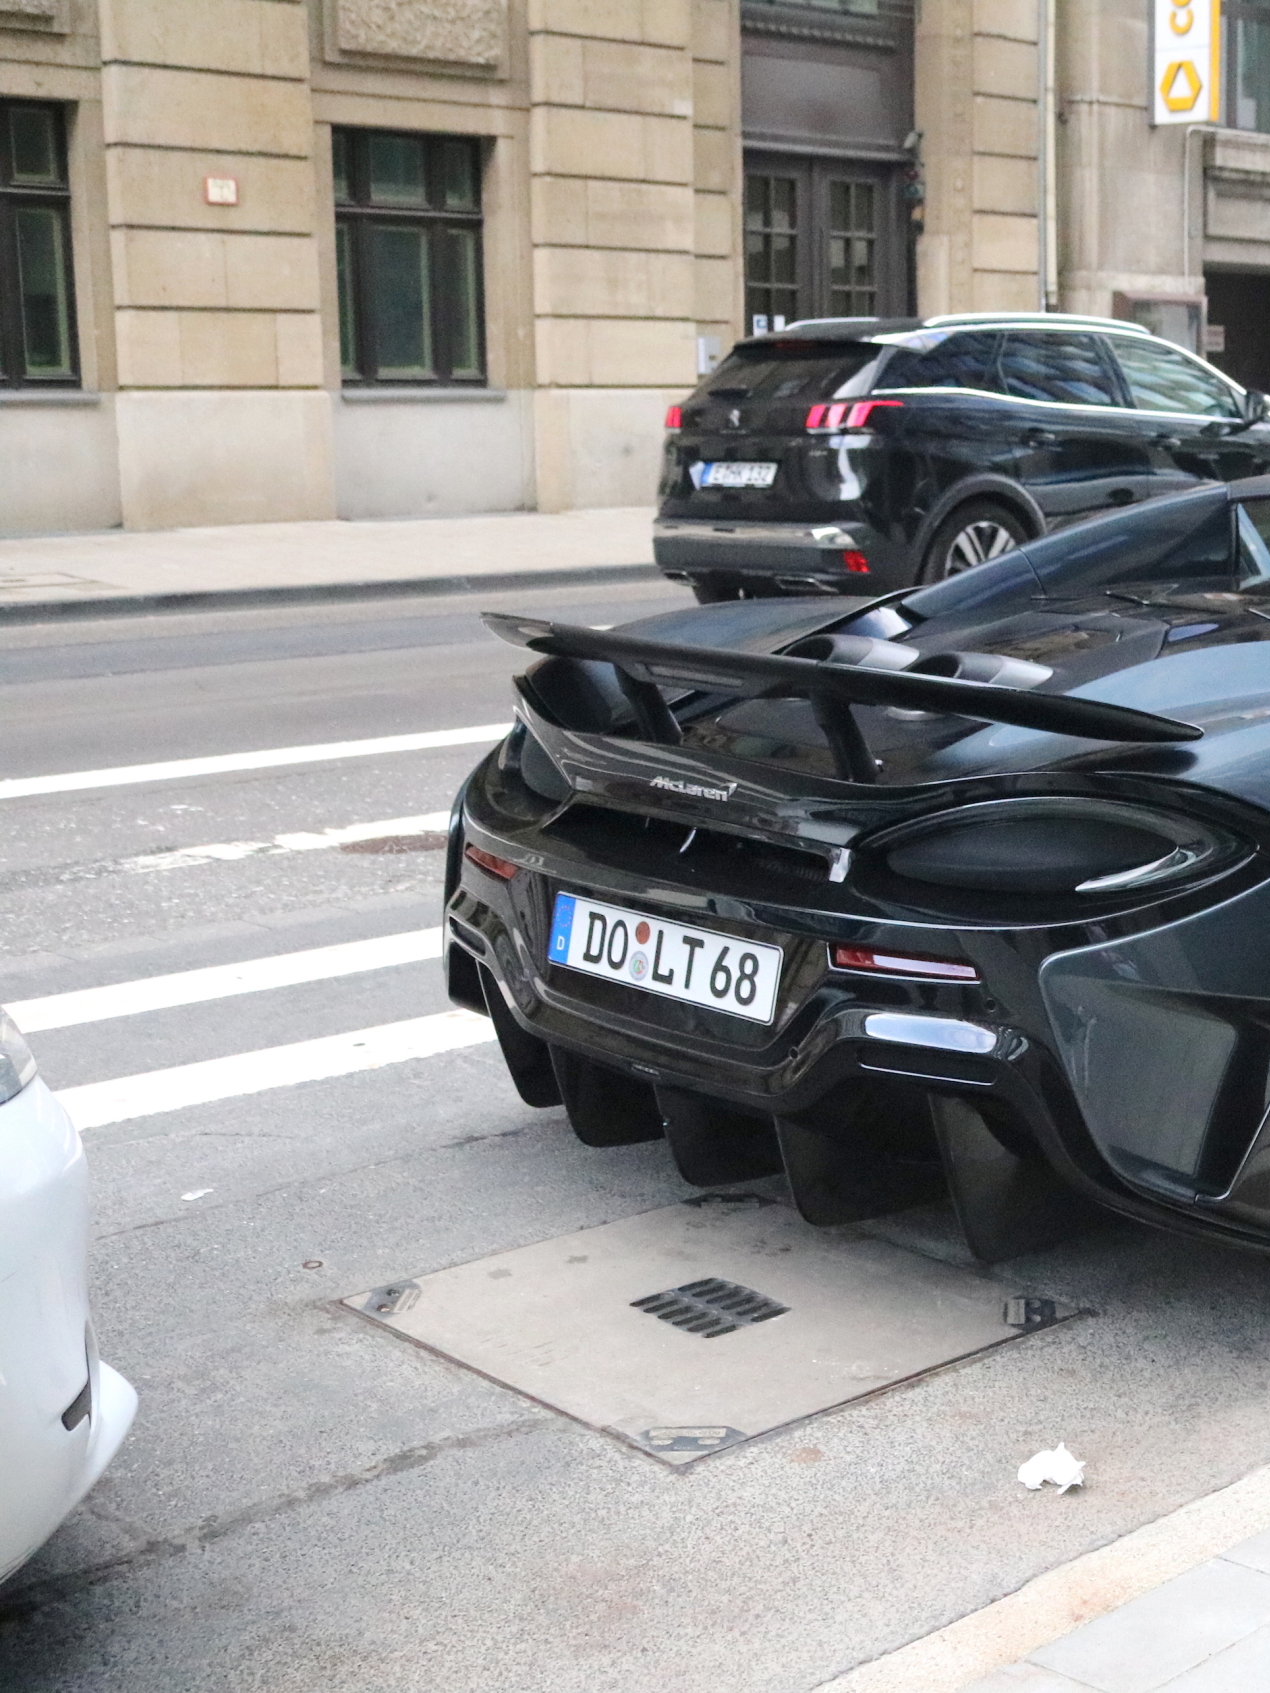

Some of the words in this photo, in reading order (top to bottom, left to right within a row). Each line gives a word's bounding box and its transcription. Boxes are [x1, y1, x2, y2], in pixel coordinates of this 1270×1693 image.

[1169, 0, 1195, 36] C
[650, 776, 730, 802] McLaren
[556, 935, 566, 951] D
[582, 911, 630, 970] DO
[652, 930, 705, 989] LT
[709, 946, 760, 1007] 68
